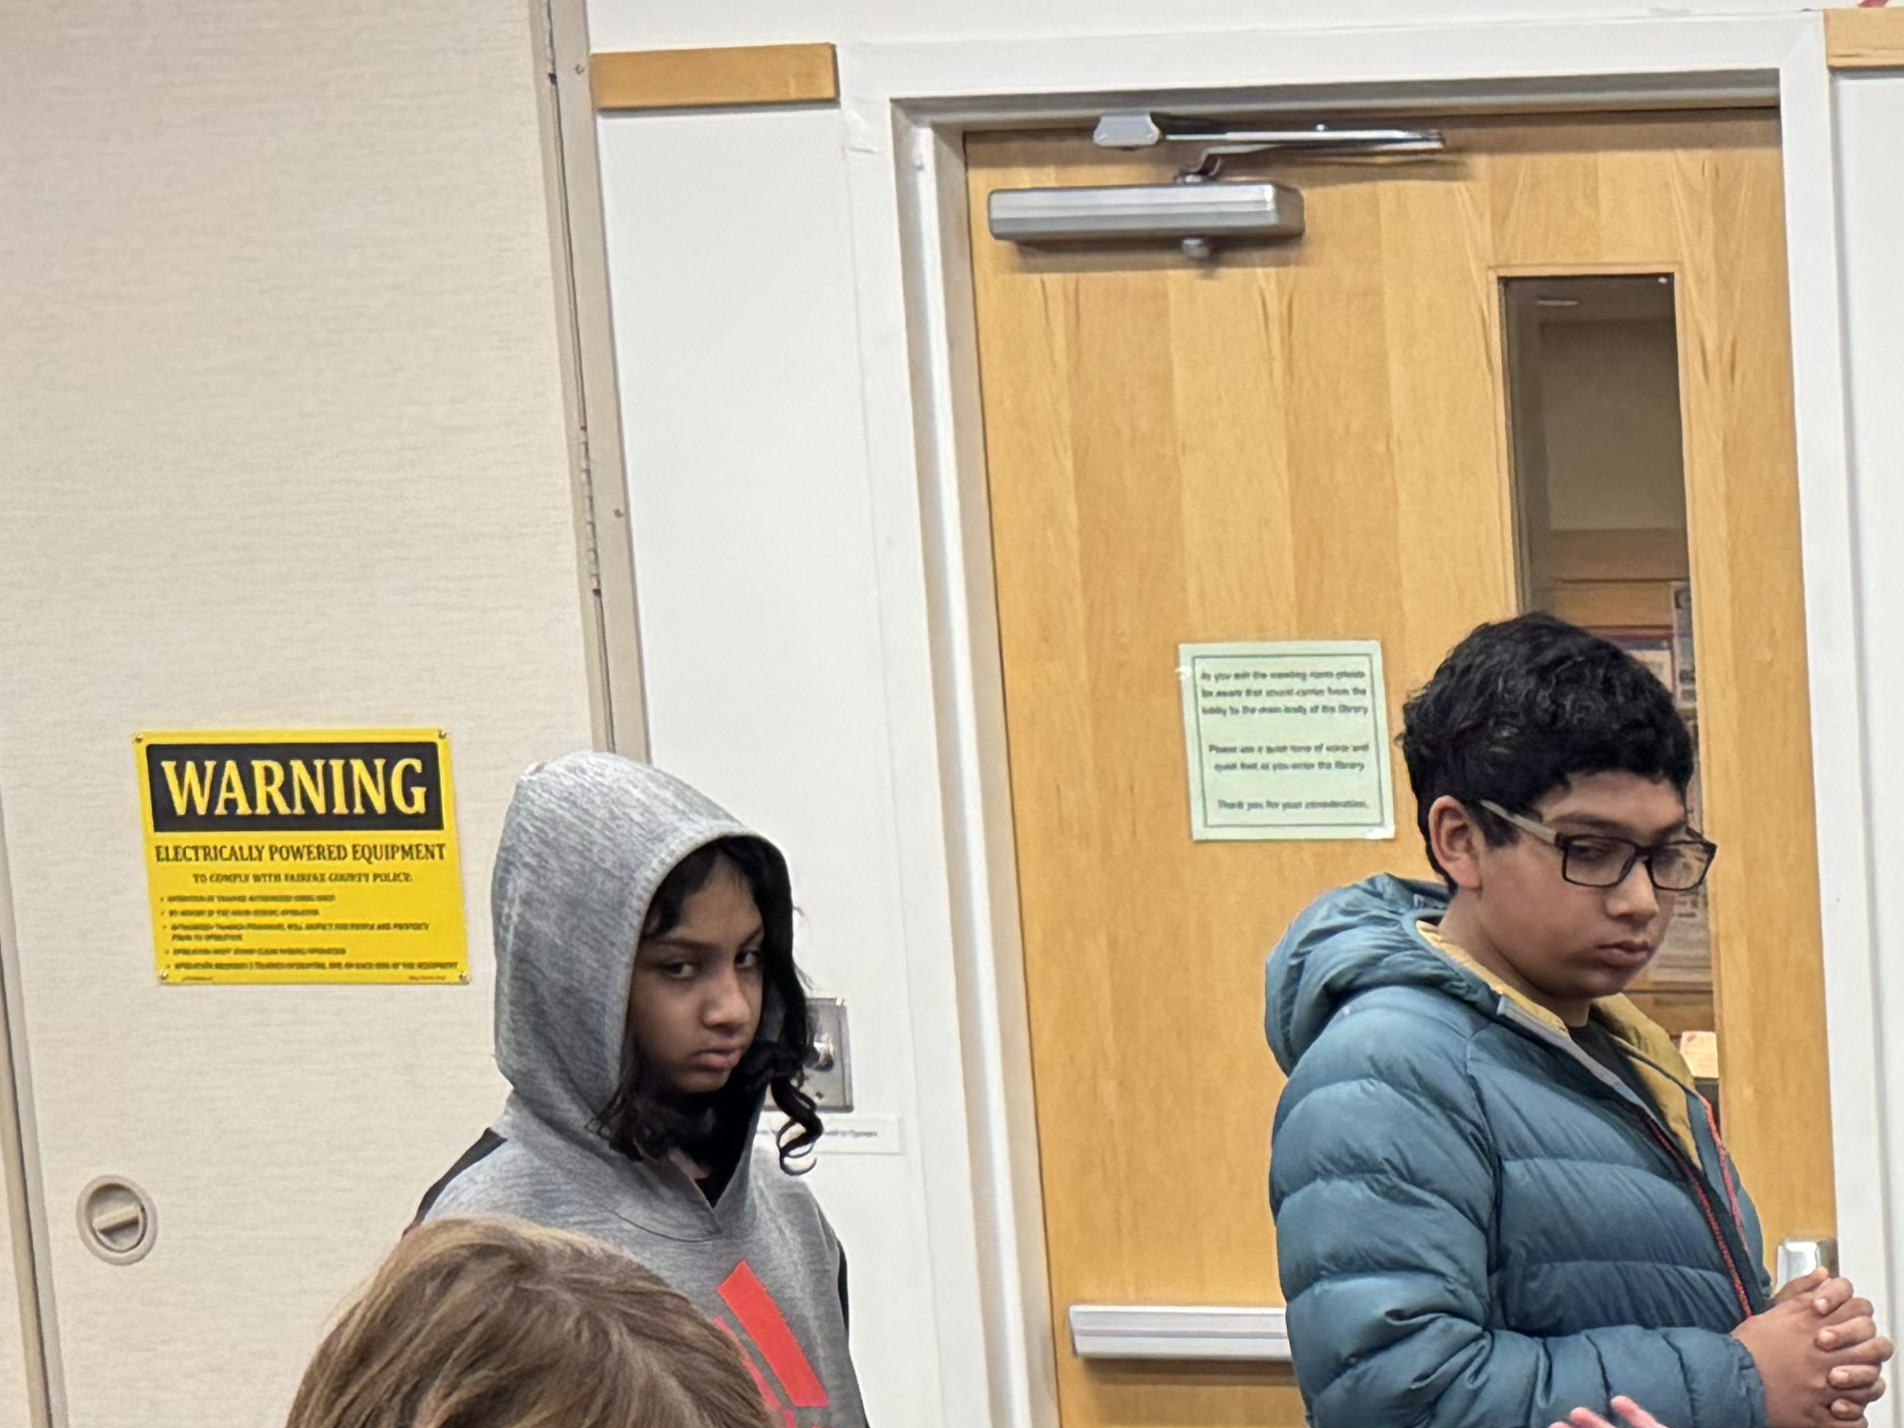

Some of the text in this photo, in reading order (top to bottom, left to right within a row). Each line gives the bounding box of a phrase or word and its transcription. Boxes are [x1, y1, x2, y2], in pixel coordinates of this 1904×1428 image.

[160, 757, 428, 816] WARNING
[155, 842, 446, 865] ELECTRICALLY POWERED EQUIPMENT
[192, 873, 208, 884] TO
[252, 872, 282, 883] WITH
[328, 872, 370, 883] COUNTY
